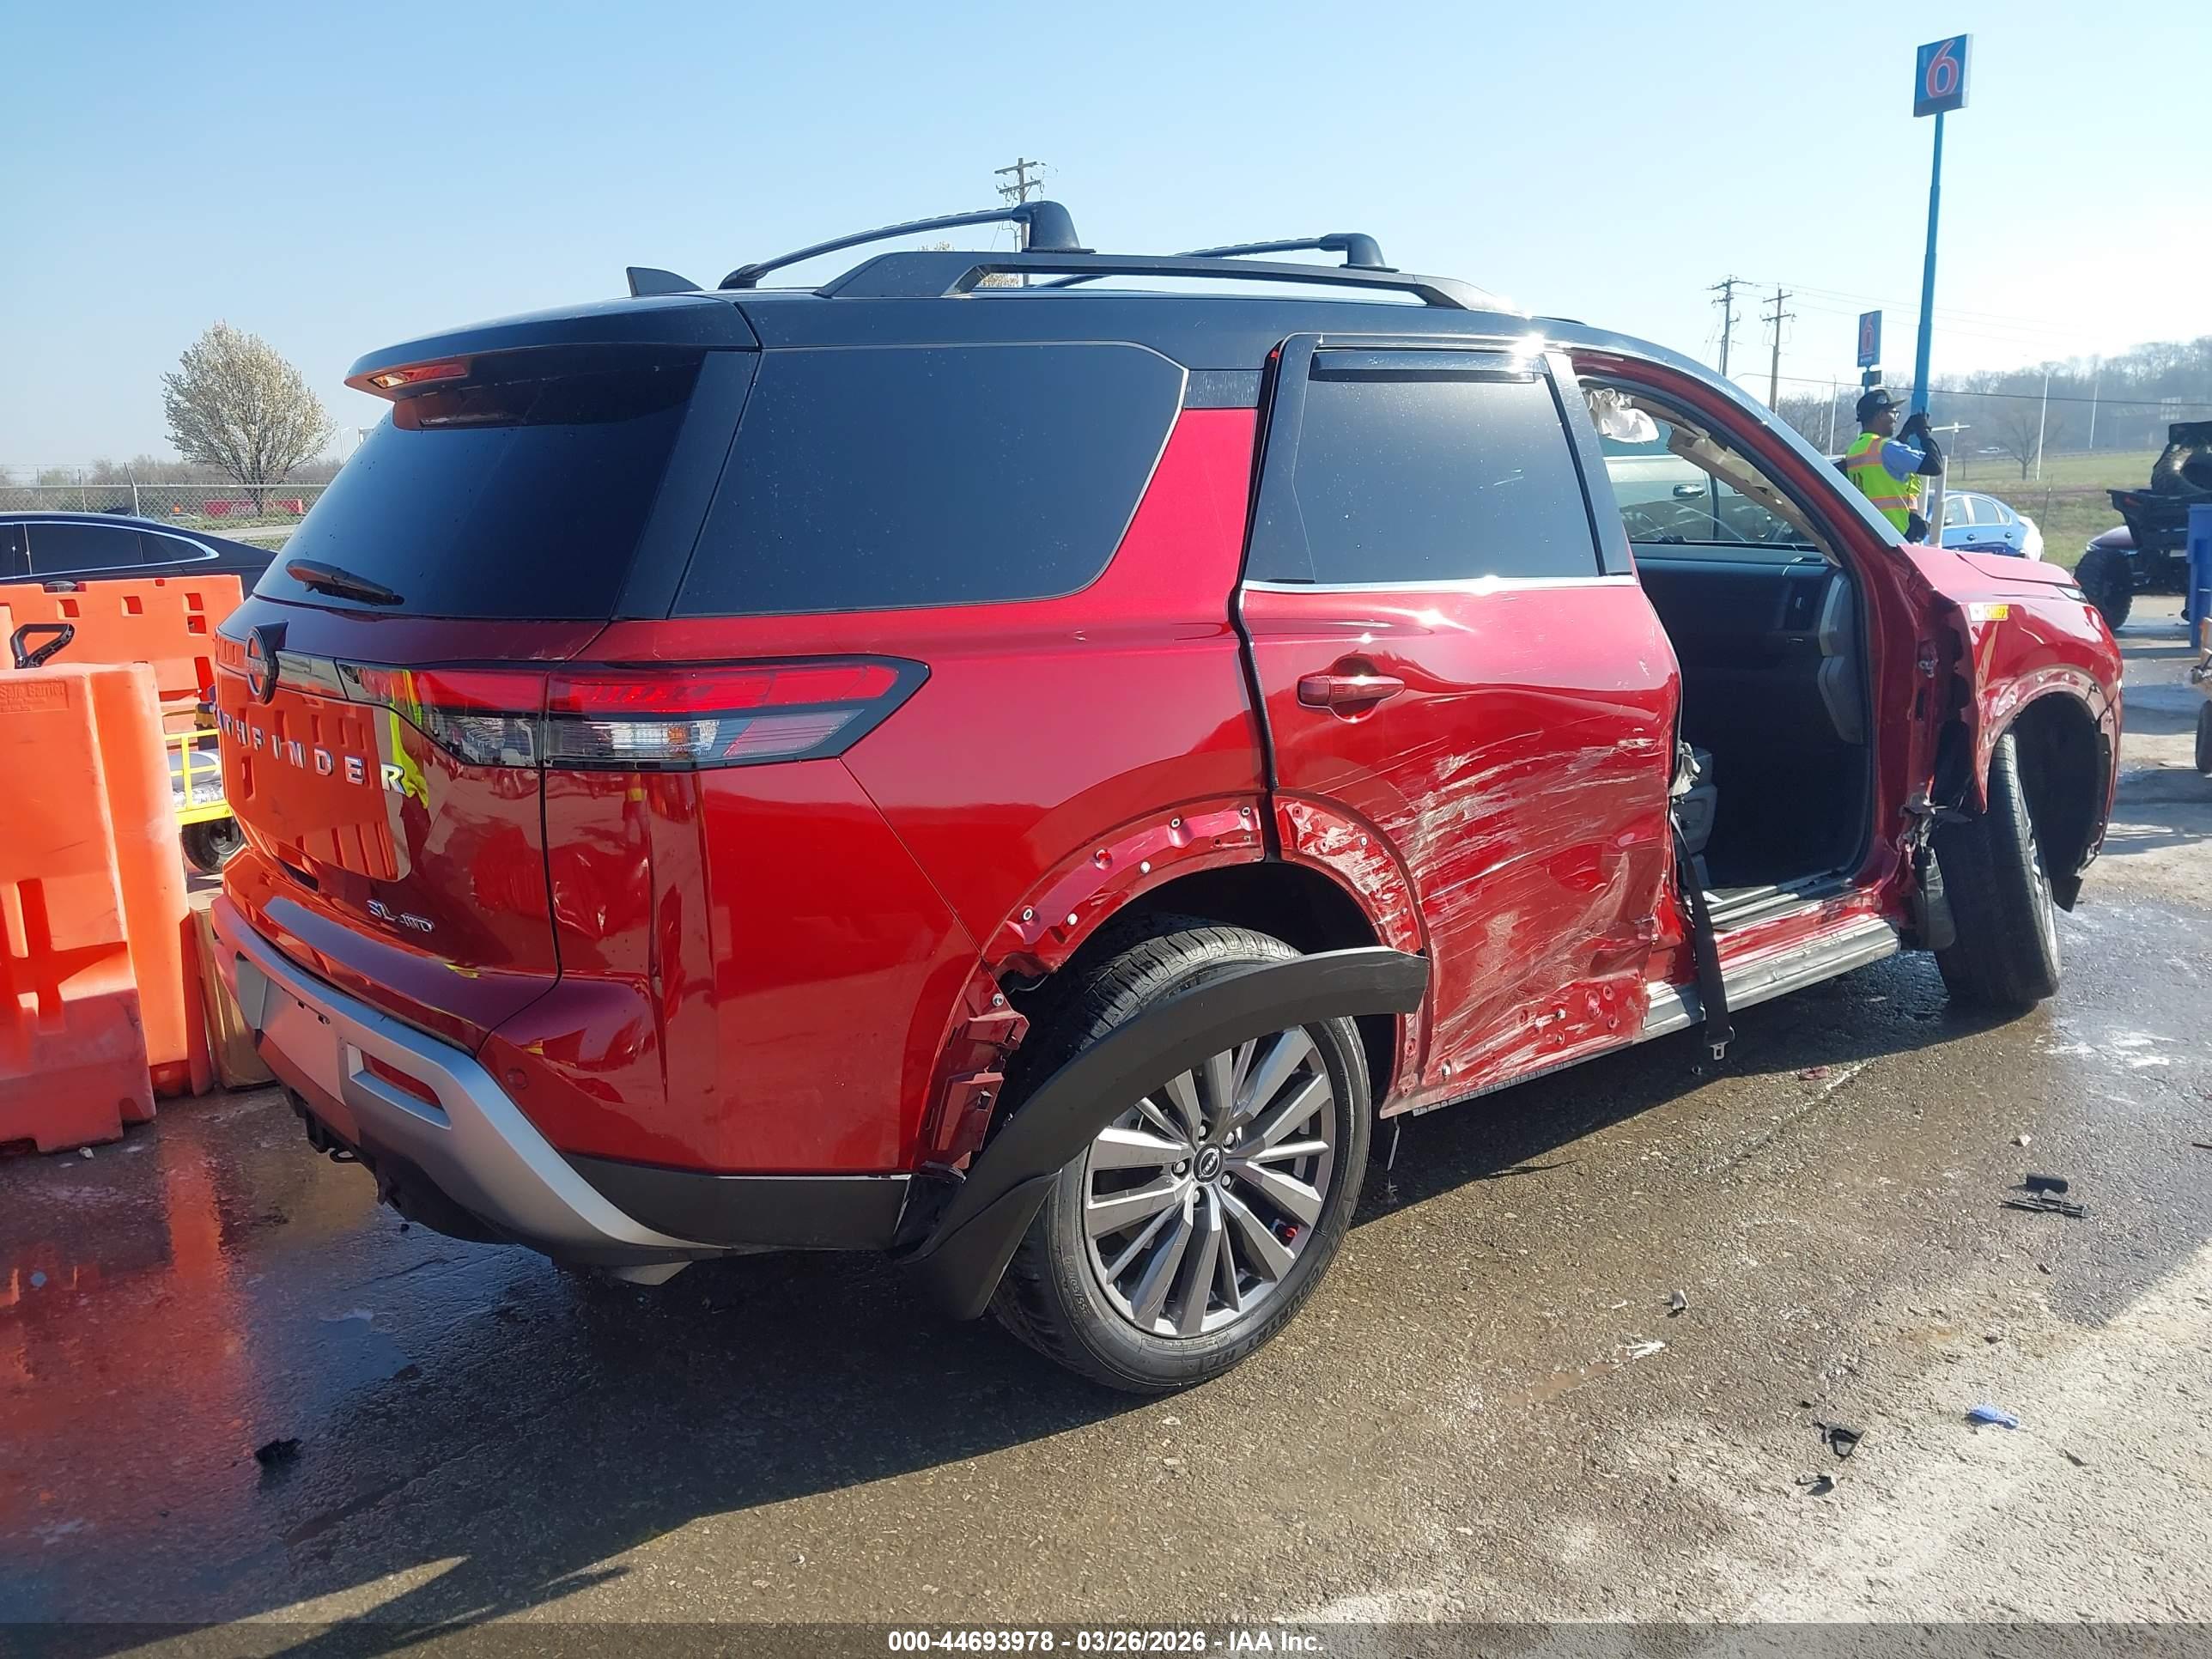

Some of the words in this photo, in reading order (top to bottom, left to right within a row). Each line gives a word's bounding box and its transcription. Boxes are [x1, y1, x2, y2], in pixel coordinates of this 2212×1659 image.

[1926, 40, 1960, 98] 6
[1862, 314, 1875, 354] 6
[366, 900, 396, 921] SL
